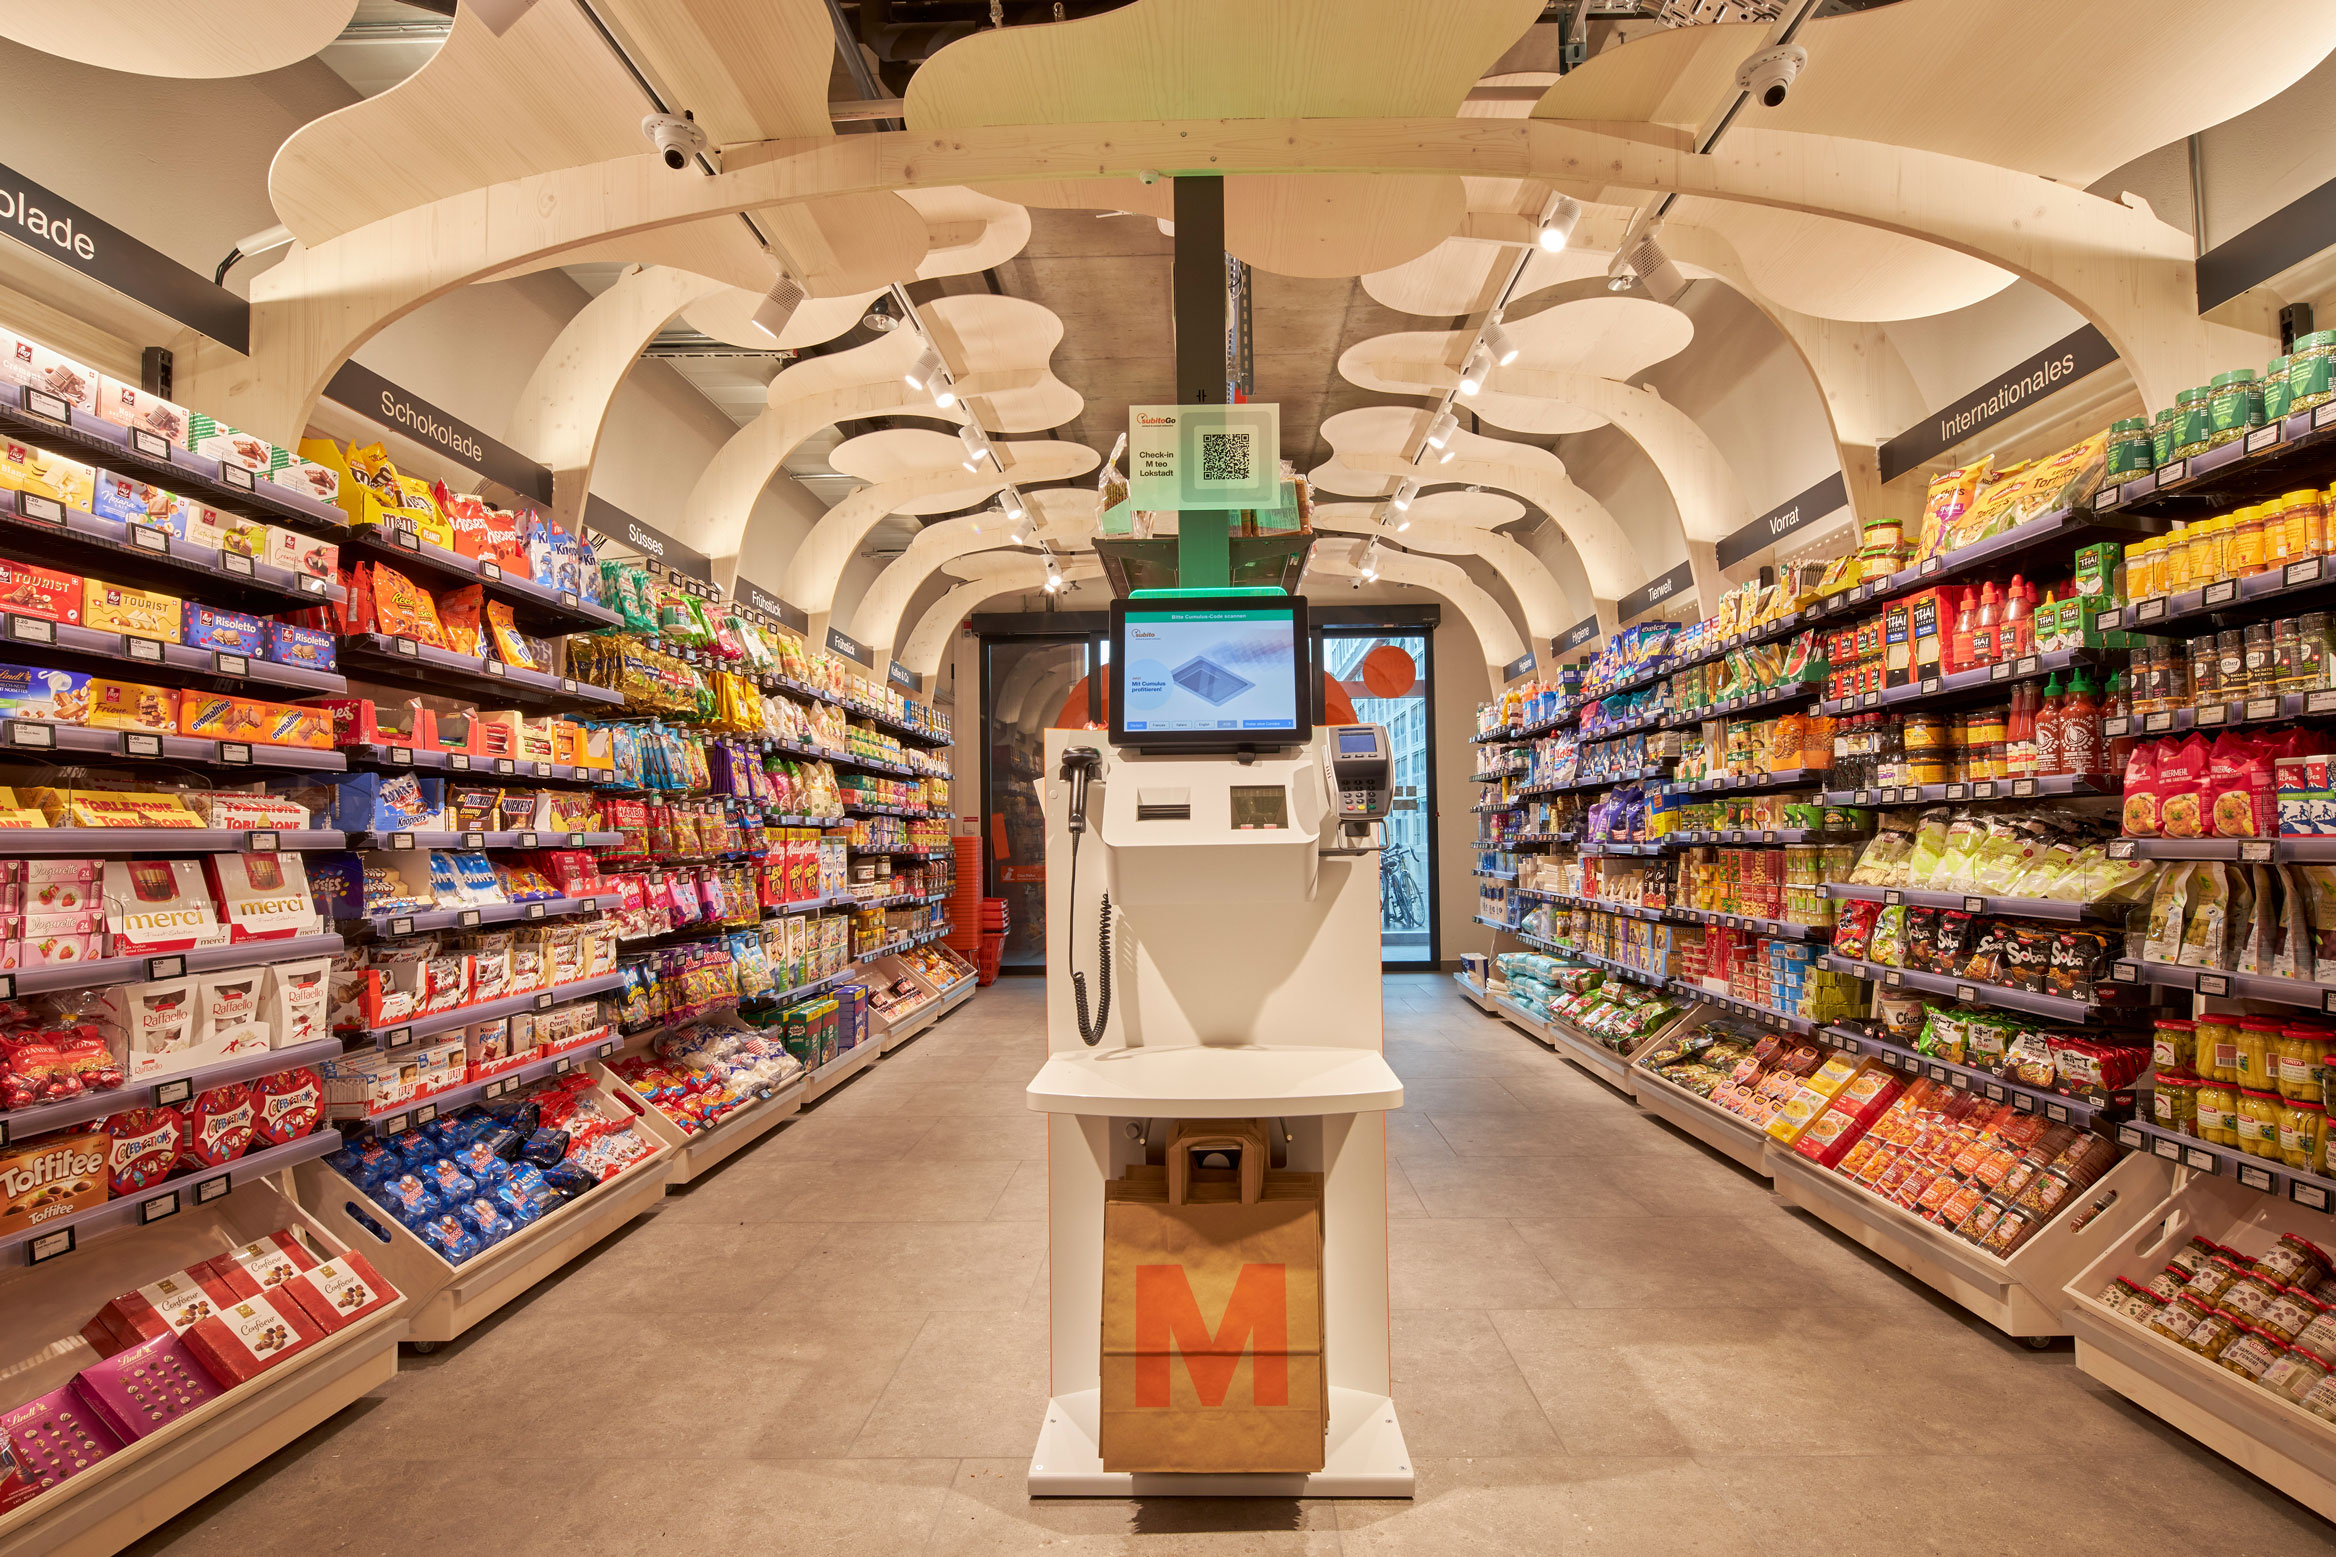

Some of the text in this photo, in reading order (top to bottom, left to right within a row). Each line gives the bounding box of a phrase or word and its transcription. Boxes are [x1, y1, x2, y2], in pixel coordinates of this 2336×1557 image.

[1941, 352, 2075, 441] Internationales
[381, 390, 483, 462] Schokolade
[1141, 415, 1176, 425] subitoGo
[1139, 451, 1174, 459] Check-in
[1154, 460, 1168, 468] teo
[1139, 469, 1174, 477] Lokstadt
[1769, 505, 1800, 535] Vorrat
[422, 528, 441, 543] PEANUT
[628, 523, 664, 556] Süsses
[2078, 554, 2098, 567] THAI
[14, 571, 70, 593] TOURIST
[1647, 578, 1673, 602] Tierwelt
[123, 595, 169, 612] TOURIST
[752, 590, 782, 618] Frühstück
[1913, 605, 1936, 620] THAI
[1886, 614, 1908, 628] THAI
[1916, 618, 1935, 626] KITCHEN
[2060, 608, 2080, 620] THAI
[215, 615, 257, 634] Risoletto
[295, 632, 330, 648] Risoletto
[1571, 625, 1590, 644] Hygiene
[834, 634, 856, 656] Frühstück
[1518, 657, 1532, 673] Hygiene
[191, 699, 232, 732] ovomaltine
[271, 709, 304, 741] ovomaltine
[2160, 767, 2189, 779] PANIERMEHL
[467, 793, 494, 807] SNICKERS
[551, 799, 582, 818] TWIX
[397, 814, 427, 828] Knoppers
[616, 806, 645, 818] HARIBO
[30, 862, 79, 879] Yogurette
[240, 895, 304, 916] merci
[27, 915, 77, 933] Yogurette
[124, 908, 204, 930] merci
[299, 927, 320, 936] merci
[1908, 923, 1931, 939] Soba
[1937, 928, 1959, 950] Soba
[200, 936, 226, 946] merci
[2005, 941, 2047, 965] Soba
[2051, 941, 2085, 967] Soba
[288, 987, 324, 1003] Raffaello
[212, 1000, 253, 1015] Raffaello
[143, 1010, 188, 1028] Raffaello
[1895, 1011, 1923, 1025] Chick
[134, 1062, 163, 1075] Raffaello
[2281, 1058, 2305, 1066] CONDY
[1, 1149, 103, 1199] Toffifee
[28, 1203, 74, 1226] Toffifee
[250, 1254, 282, 1273] Confiseur
[324, 1276, 355, 1294] Confiseur
[161, 1291, 199, 1312] Confiseur
[240, 1315, 276, 1336] Confiseur
[1135, 1263, 1289, 1408] M
[2237, 1344, 2271, 1368] CHAMPIGNONS
[2250, 1341, 2269, 1355] CONDY
[117, 1348, 146, 1367] Lindt
[7, 1405, 38, 1427] Lindt
